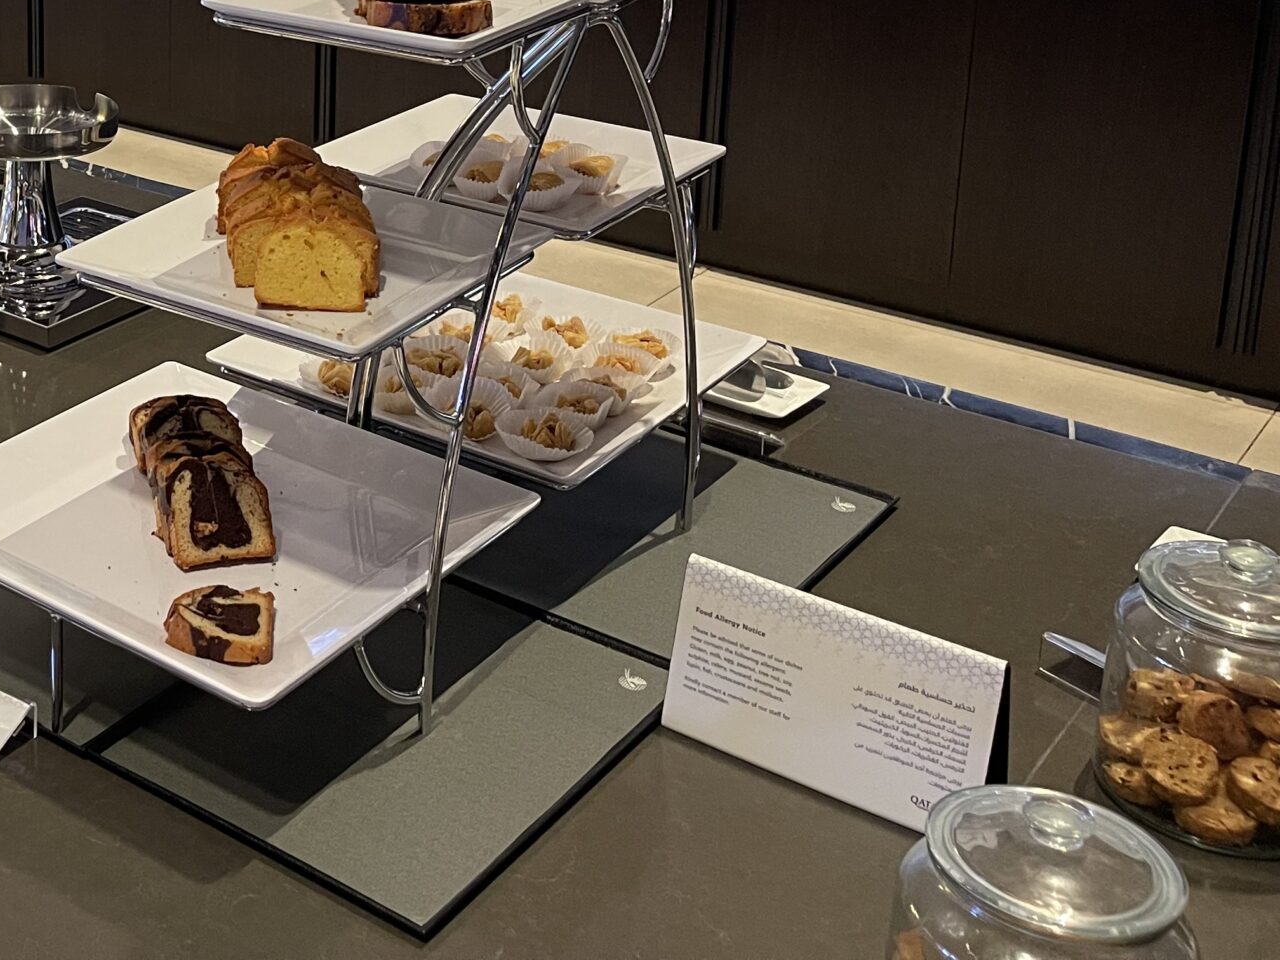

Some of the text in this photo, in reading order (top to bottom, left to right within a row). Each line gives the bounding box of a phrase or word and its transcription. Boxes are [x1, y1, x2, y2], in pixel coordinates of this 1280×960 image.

[696, 607, 765, 637] Food Allergy Notice
[898, 683, 975, 713] تحذير حساسية طعام
[910, 795, 931, 808] QAT
